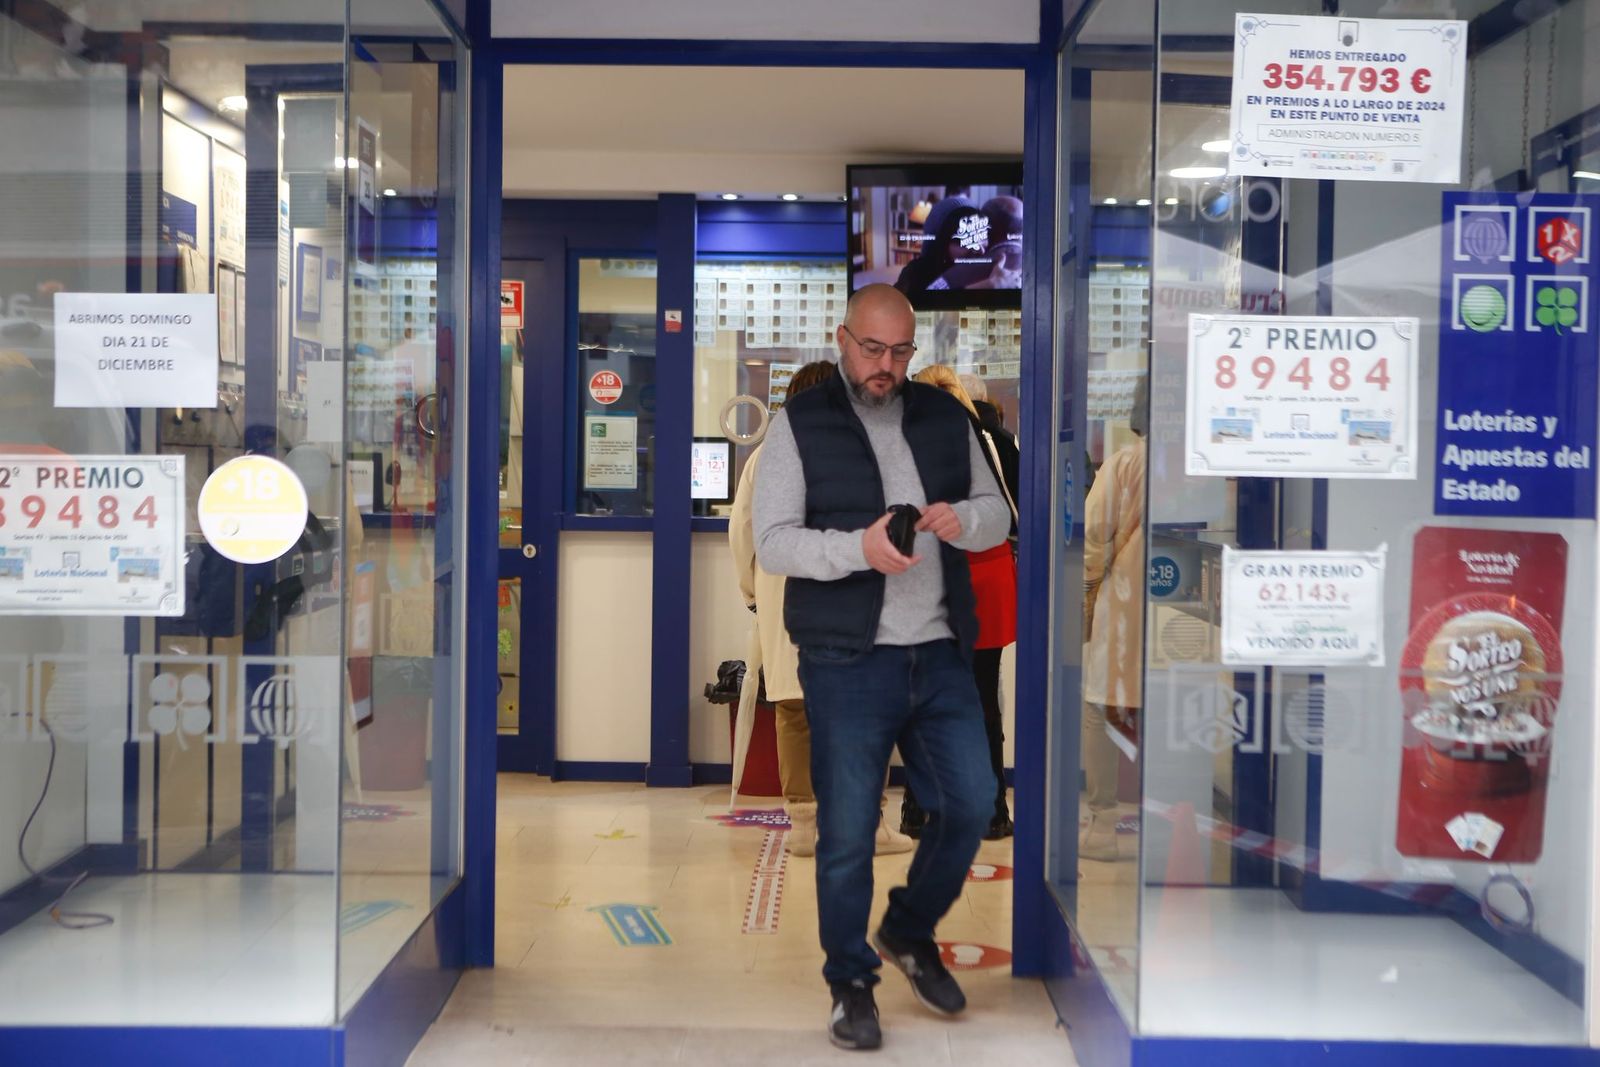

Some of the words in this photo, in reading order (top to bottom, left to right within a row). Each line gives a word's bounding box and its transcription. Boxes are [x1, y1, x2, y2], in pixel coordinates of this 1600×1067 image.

[1289, 49, 1332, 61] HEMOS
[1335, 51, 1407, 63] ENTREGADO
[1263, 63, 1400, 94] 354.793
[1411, 68, 1432, 94] €
[1247, 95, 1262, 105] EN
[1266, 96, 1320, 108] PREMIOS
[1323, 98, 1332, 107] A
[1334, 99, 1350, 109] LO
[1353, 99, 1393, 110] LARGO
[1397, 101, 1413, 110] DE
[1417, 101, 1446, 111] 2024
[1270, 109, 1286, 119] EN
[1289, 110, 1317, 120] ESTE
[1320, 111, 1359, 121] PUNTO
[1363, 112, 1378, 122] DE
[1382, 113, 1421, 123] VENTA
[1268, 128, 1360, 141] ADMINISTRACION
[1362, 131, 1409, 142] NUMERO
[68, 313, 124, 325] ABRIMOS
[130, 314, 192, 325] DOMINGO
[102, 336, 127, 348] DIA
[130, 336, 147, 348] 21
[151, 336, 169, 348] DE
[1267, 328, 1377, 350] PREMIO
[98, 359, 175, 371] DICIEMBRE
[597, 374, 615, 386] +18
[1444, 409, 1538, 432] Loterías
[1541, 415, 1558, 438] y
[1442, 444, 1548, 471] Apuestas
[1554, 445, 1590, 469] del
[36, 467, 145, 489] PREMIO
[222, 467, 282, 500] +18
[1441, 478, 1520, 501] Estado
[1242, 564, 1293, 578] GRAN
[1299, 564, 1364, 578] PREMIO
[1246, 637, 1314, 649] VENDIDO
